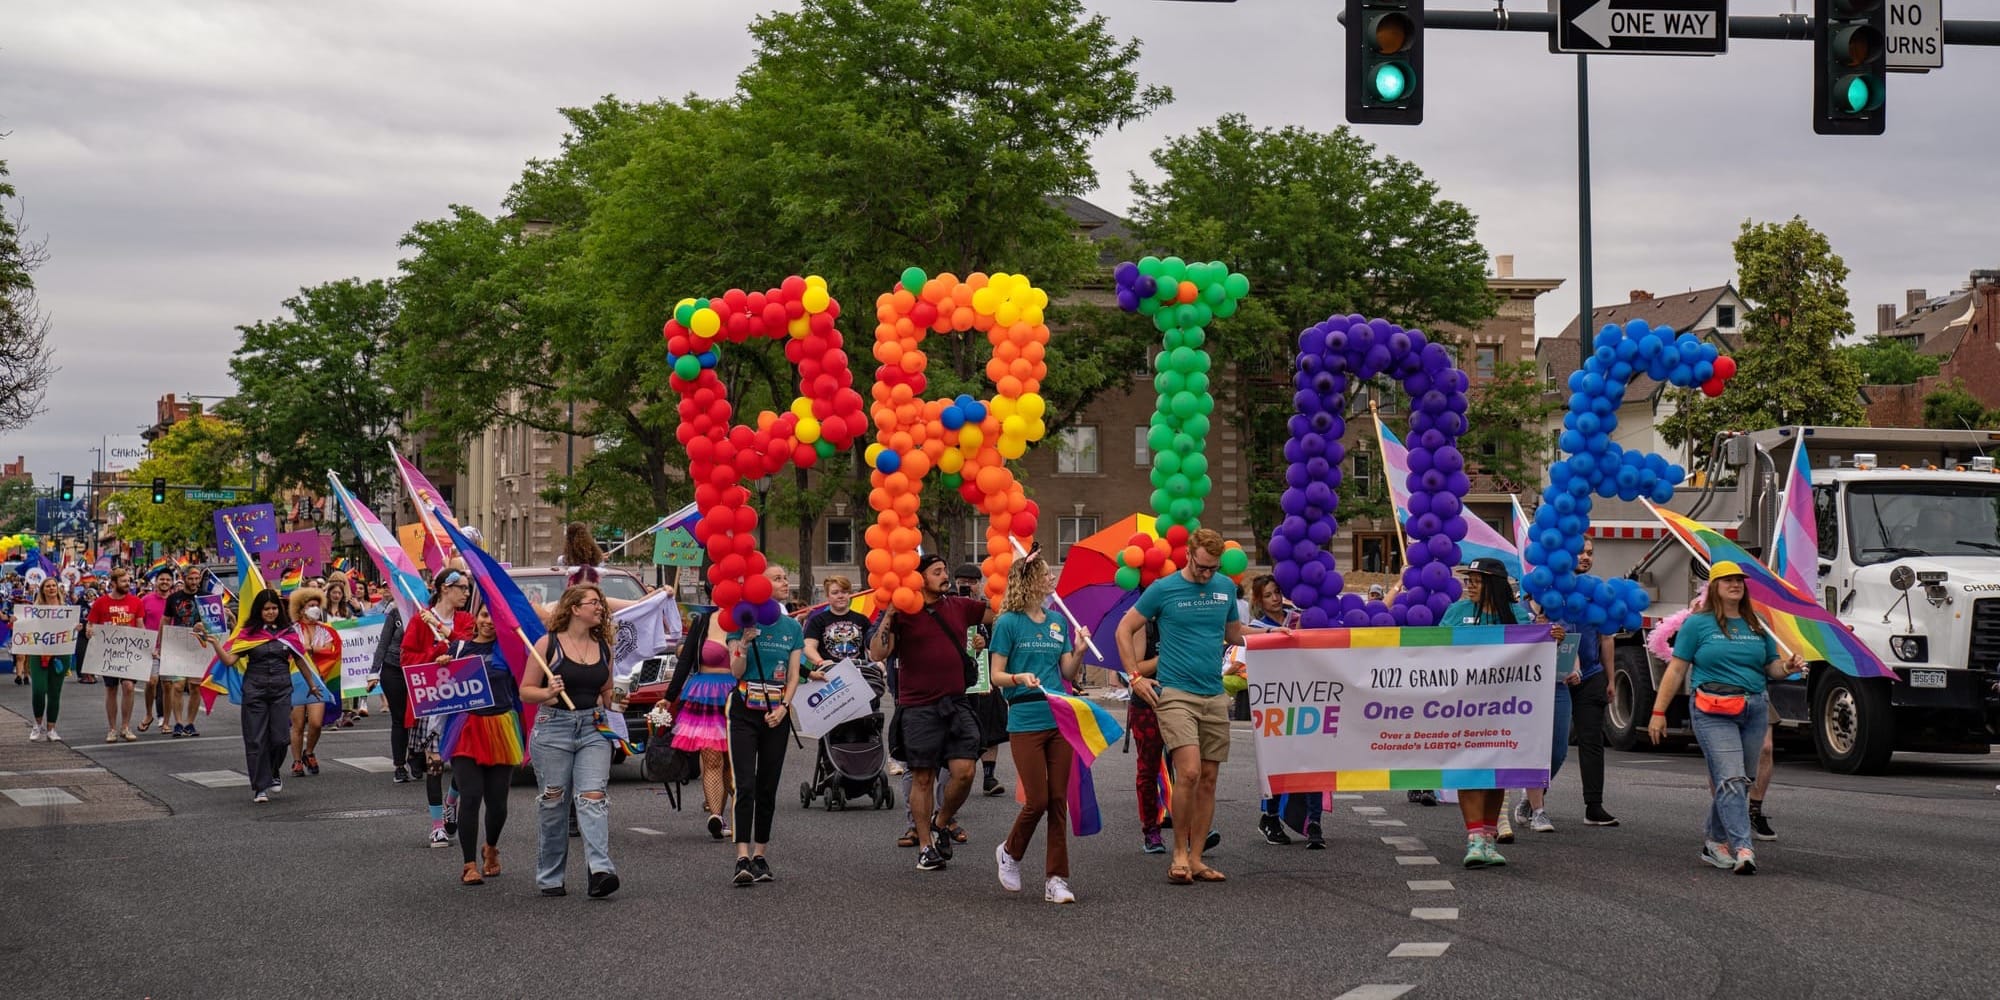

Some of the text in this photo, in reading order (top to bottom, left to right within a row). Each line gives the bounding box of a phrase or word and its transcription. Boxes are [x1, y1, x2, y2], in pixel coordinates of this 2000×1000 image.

[1611, 12, 1709, 35] ONE WAY
[1890, 4, 1922, 26] NO
[1886, 36, 1937, 55] URNS
[24, 606, 73, 619] PROTECT
[410, 672, 426, 686] Bi
[1370, 664, 1542, 689] 2022 GRAND MARSHALS
[414, 679, 483, 703] PROUD
[807, 676, 846, 708] ONE
[1363, 696, 1533, 720] One Colorado
[1380, 731, 1402, 740] Over
[1413, 730, 1449, 739] Decade
[1452, 730, 1461, 738] of
[1463, 728, 1498, 738] Service
[1501, 728, 1511, 737] to
[1370, 740, 1519, 751] Colorado's LGBTQ+ Community
